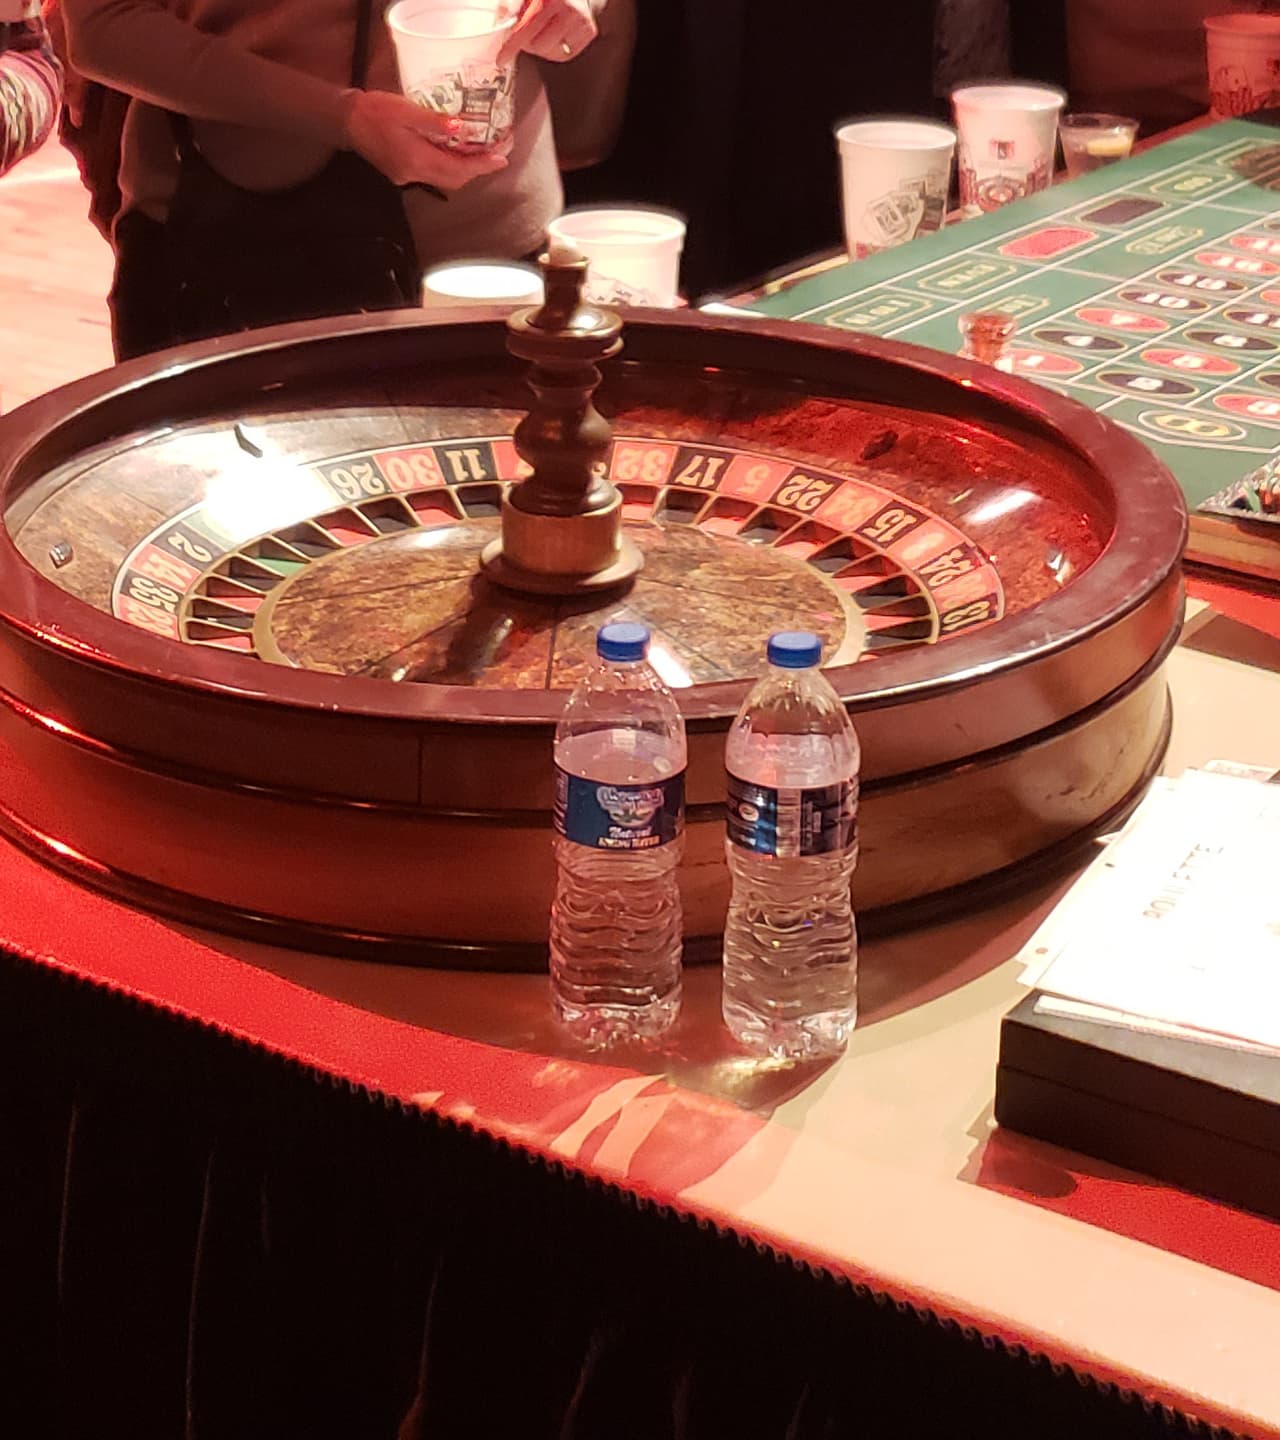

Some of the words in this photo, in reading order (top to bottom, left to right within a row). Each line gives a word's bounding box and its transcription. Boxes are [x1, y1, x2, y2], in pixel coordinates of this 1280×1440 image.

[387, 457, 438, 489] 30
[444, 448, 489, 482] 11
[676, 455, 725, 488] 17
[737, 465, 771, 495] 5
[330, 466, 386, 498] 26
[777, 473, 834, 510] 22
[862, 507, 919, 544] 15
[167, 534, 213, 563] 2
